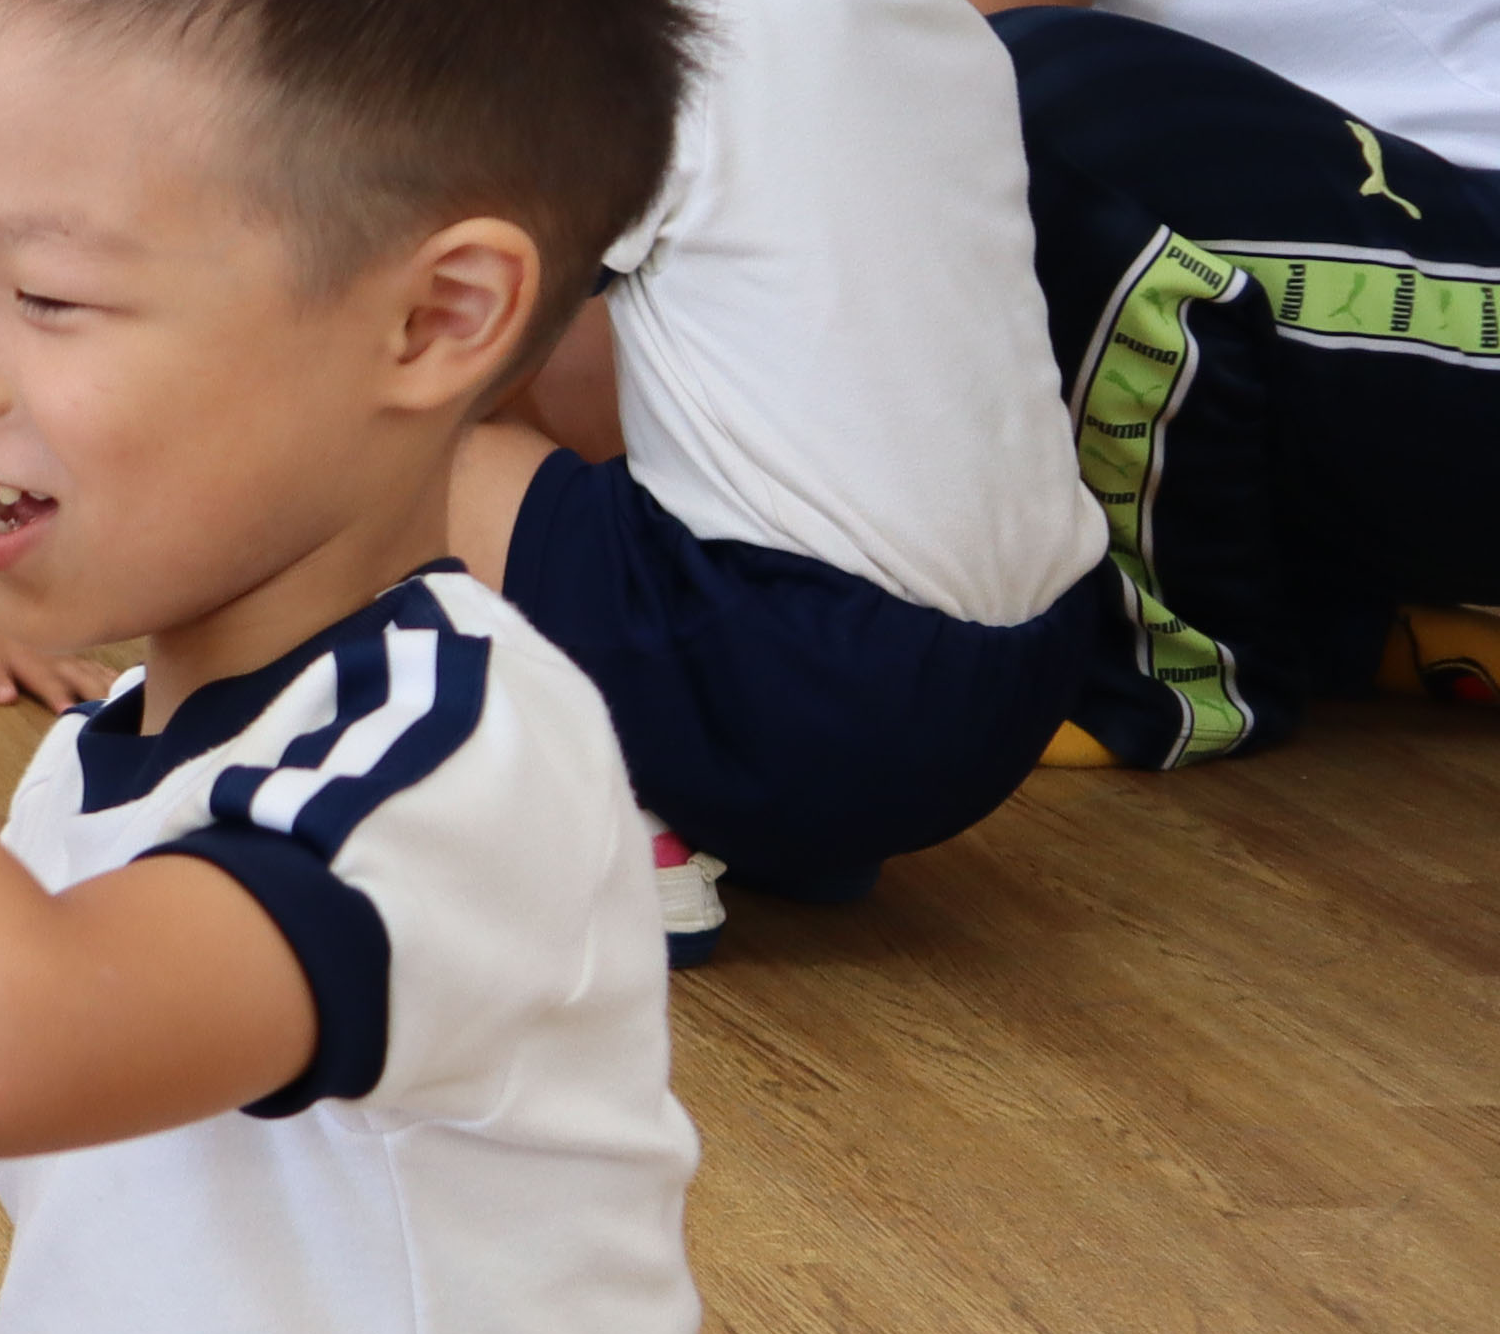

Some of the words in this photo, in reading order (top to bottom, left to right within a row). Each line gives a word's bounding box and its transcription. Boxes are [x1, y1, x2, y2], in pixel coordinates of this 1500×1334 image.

[1166, 245, 1224, 290] PUMA
[1279, 264, 1306, 322] PUMA
[1390, 273, 1416, 333] PUMA
[1480, 286, 1499, 349] PUMA
[1114, 332, 1179, 365] PUMA
[1085, 414, 1147, 439] PUMA
[1157, 665, 1218, 683] PUMA
